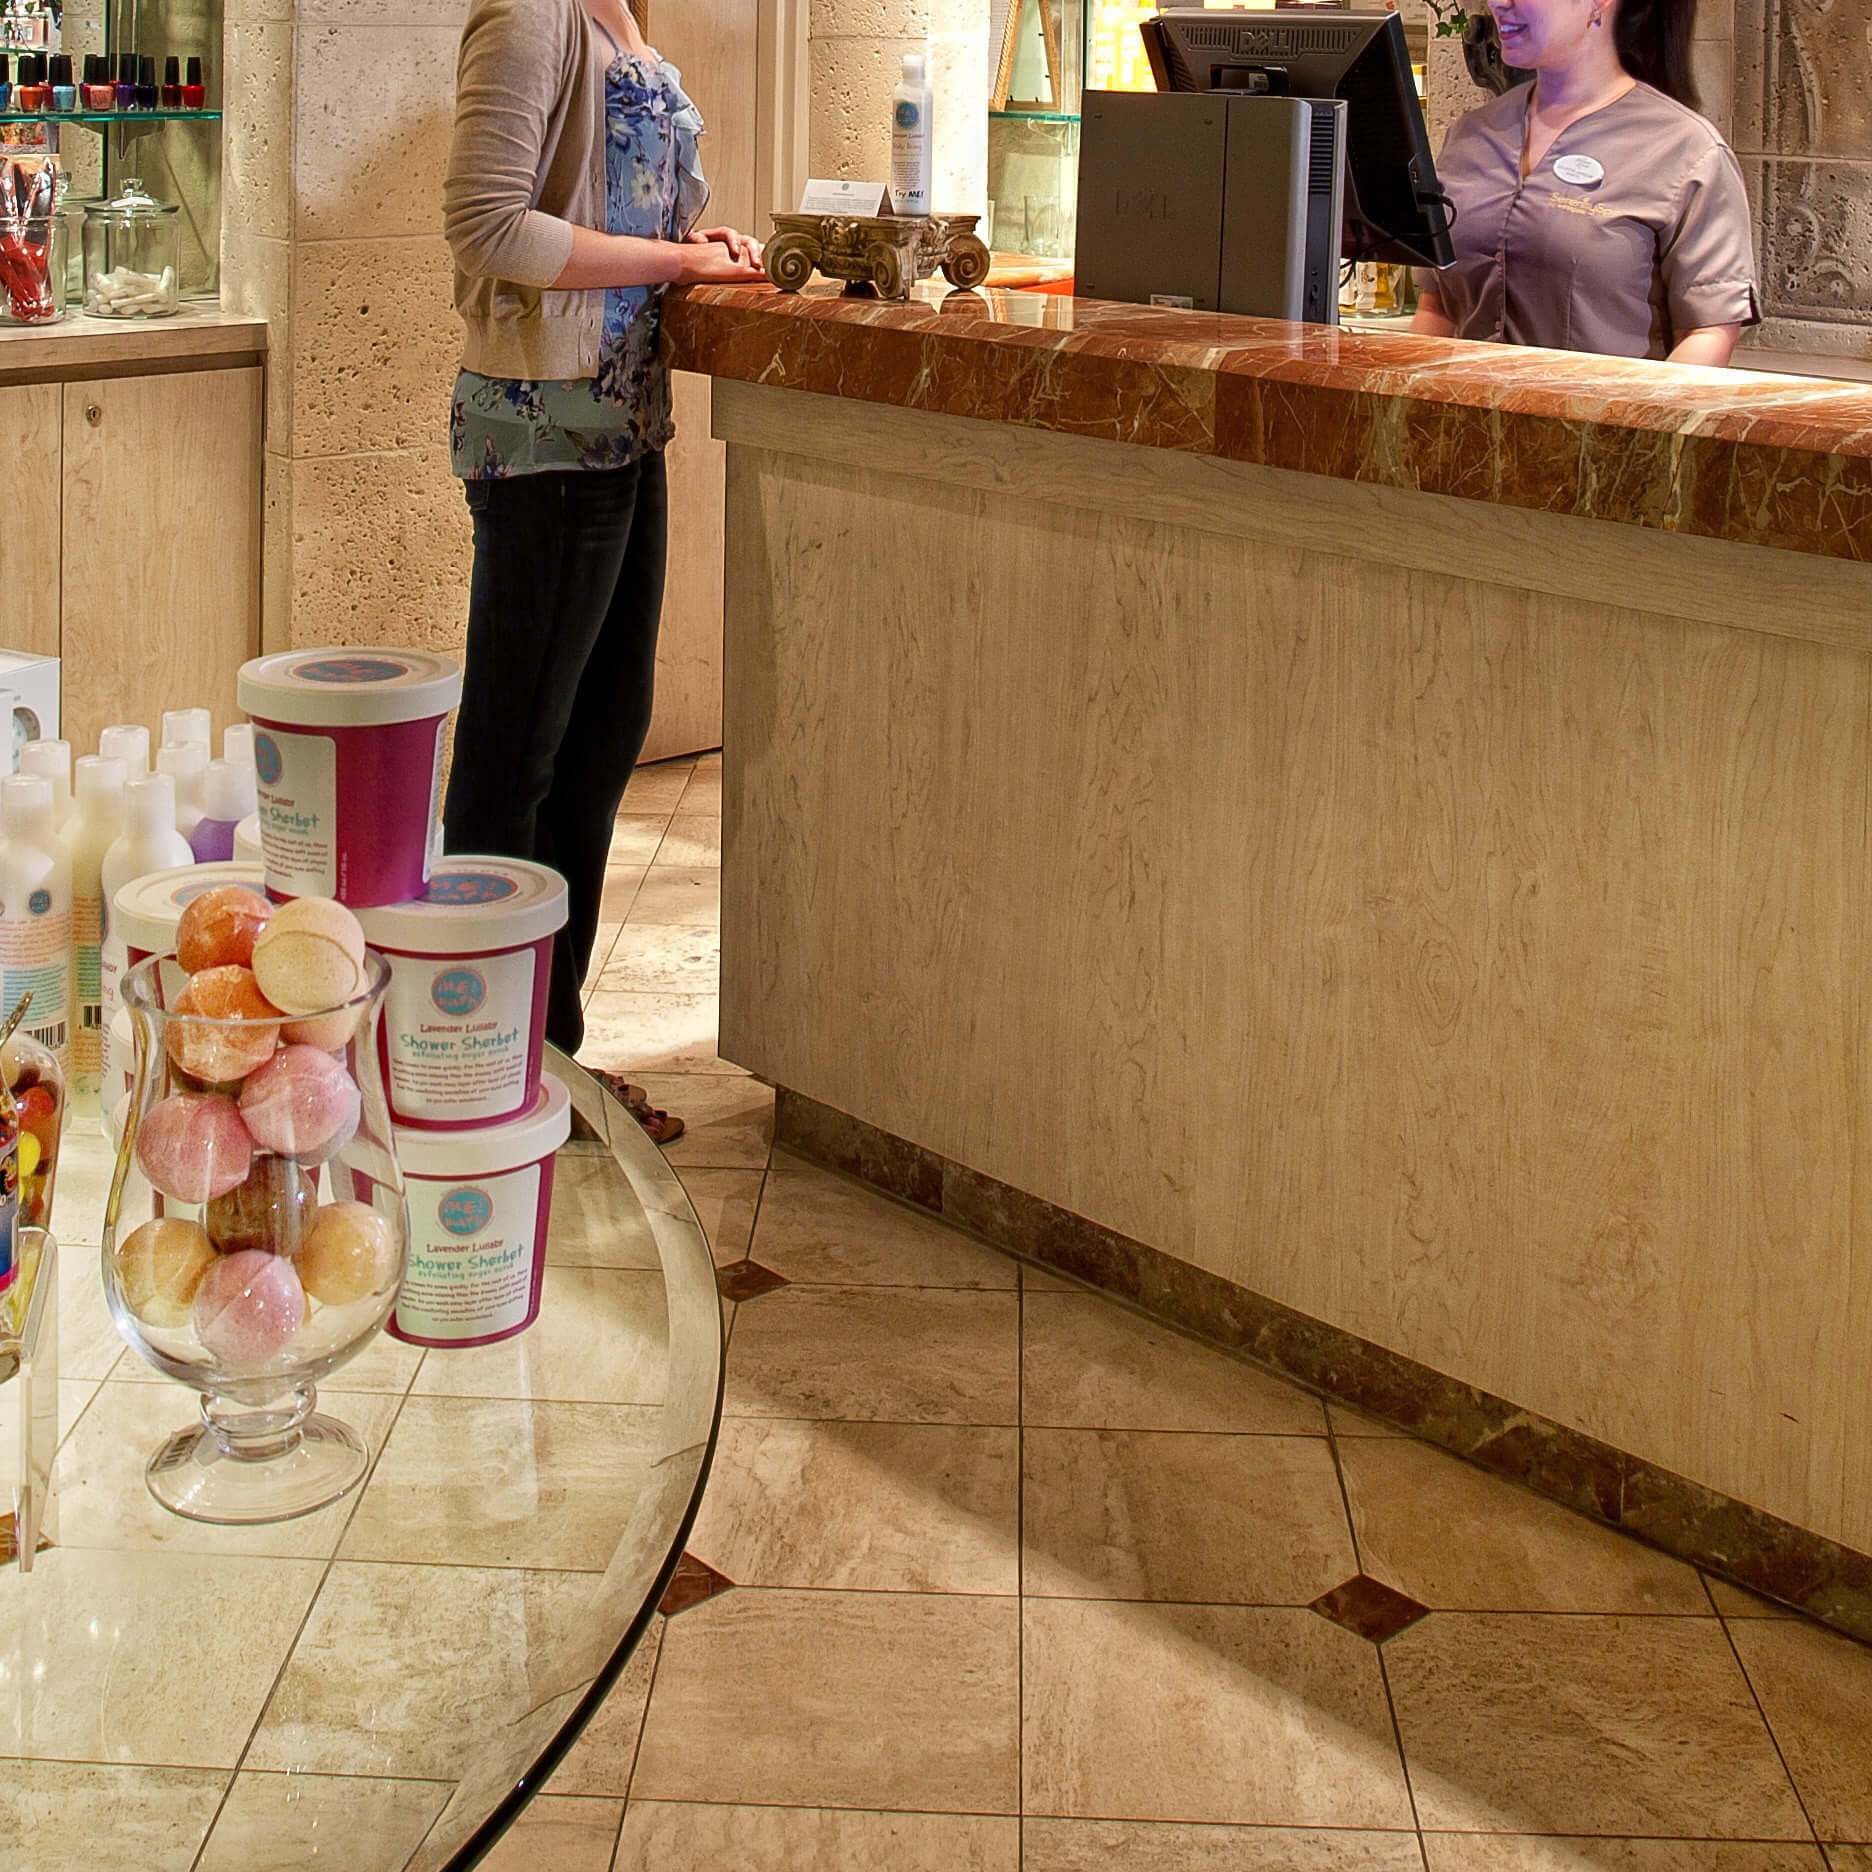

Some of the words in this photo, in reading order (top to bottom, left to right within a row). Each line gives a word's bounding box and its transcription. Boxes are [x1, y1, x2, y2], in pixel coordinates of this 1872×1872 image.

[895, 189, 906, 198] Try
[270, 807, 321, 829] Sherbet
[420, 1023, 463, 1034] Lavender
[465, 1021, 499, 1034] Lullaby
[400, 1033, 457, 1052] Shower
[461, 1027, 519, 1051] Sherbet
[426, 1243, 469, 1254] Lavender
[472, 1239, 504, 1251] Lullaby
[407, 1253, 463, 1271] Shower
[467, 1243, 524, 1270] Sherbet
